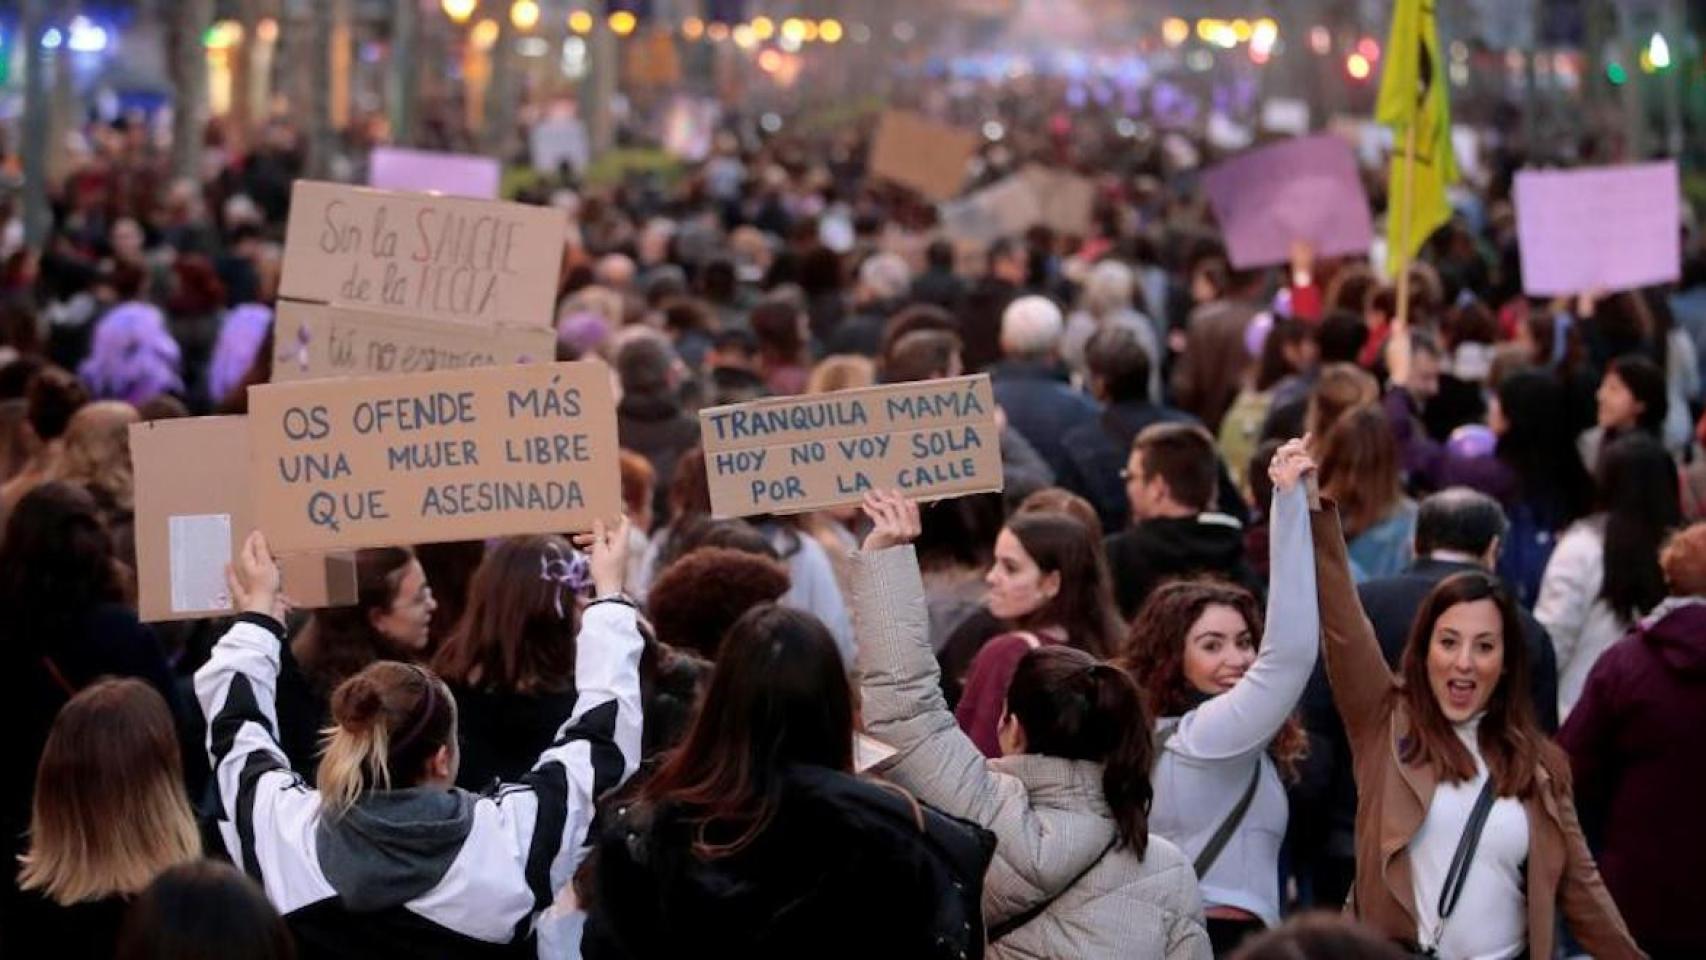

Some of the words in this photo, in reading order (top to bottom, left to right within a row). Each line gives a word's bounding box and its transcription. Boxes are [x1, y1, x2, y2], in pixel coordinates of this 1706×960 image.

[371, 205, 397, 258] la
[341, 266, 368, 299] de
[381, 263, 405, 304] la
[282, 406, 331, 441] OS
[352, 392, 477, 435] OFENDE
[507, 375, 582, 419] MÁS
[710, 400, 868, 440] TRANQUILA
[886, 380, 984, 421] MAMÁ
[279, 452, 352, 484] UNA
[387, 440, 479, 471] MUJER
[505, 434, 590, 465] LIBRE
[716, 449, 767, 475] HOY
[790, 442, 825, 467] NO
[838, 435, 891, 462] VOY
[911, 426, 982, 458] SOLA
[751, 475, 806, 504] POR
[837, 472, 872, 495] LA
[897, 457, 977, 489] CALLE
[307, 490, 390, 532] QUE
[420, 481, 585, 517] ASESINADA
